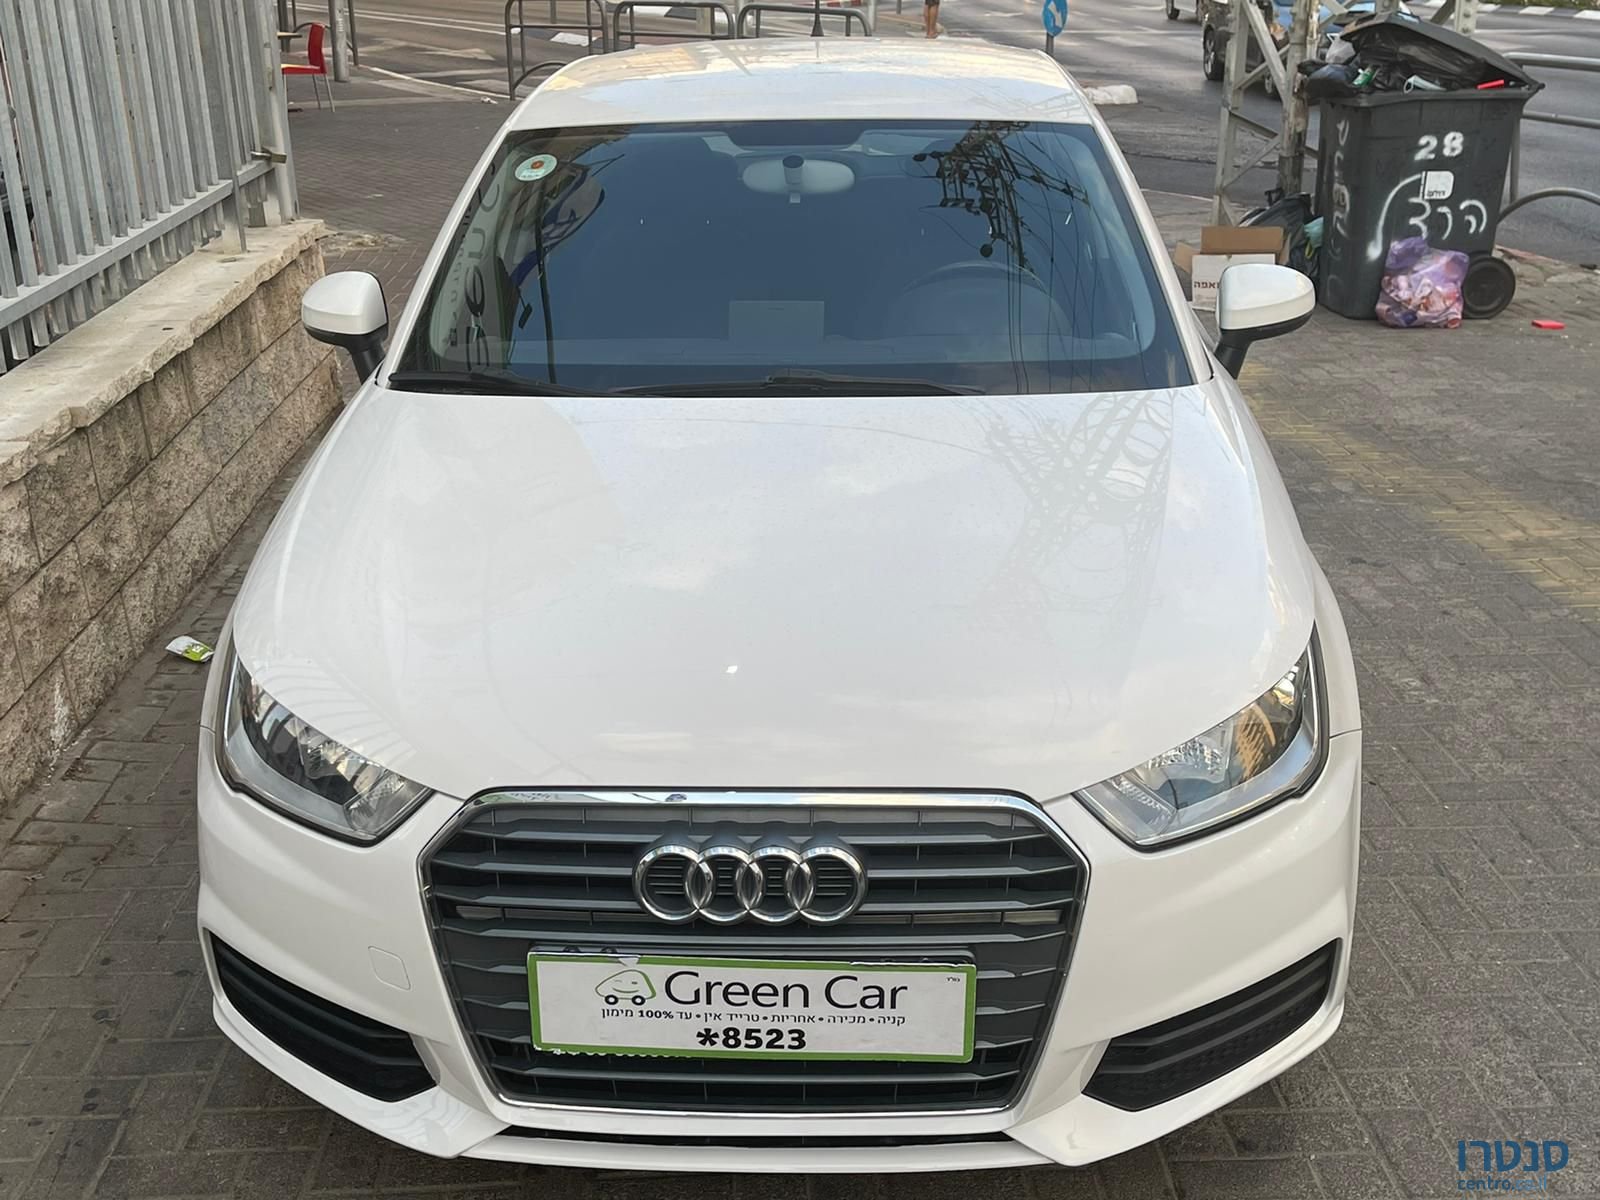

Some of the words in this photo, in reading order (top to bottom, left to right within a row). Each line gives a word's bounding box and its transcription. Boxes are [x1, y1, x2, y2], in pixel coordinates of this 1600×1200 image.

[1414, 131, 1464, 161] 28
[664, 970, 810, 1009] Green
[824, 975, 908, 1010] Car
[601, 1008, 634, 1019] מימון
[638, 1009, 674, 1020] 100%
[675, 1011, 693, 1020] עד
[703, 1012, 722, 1023] אין
[726, 1012, 760, 1023] טרייד
[770, 1014, 816, 1024] אחריות
[827, 1015, 866, 1025] מכירה
[877, 1015, 906, 1027] קניה
